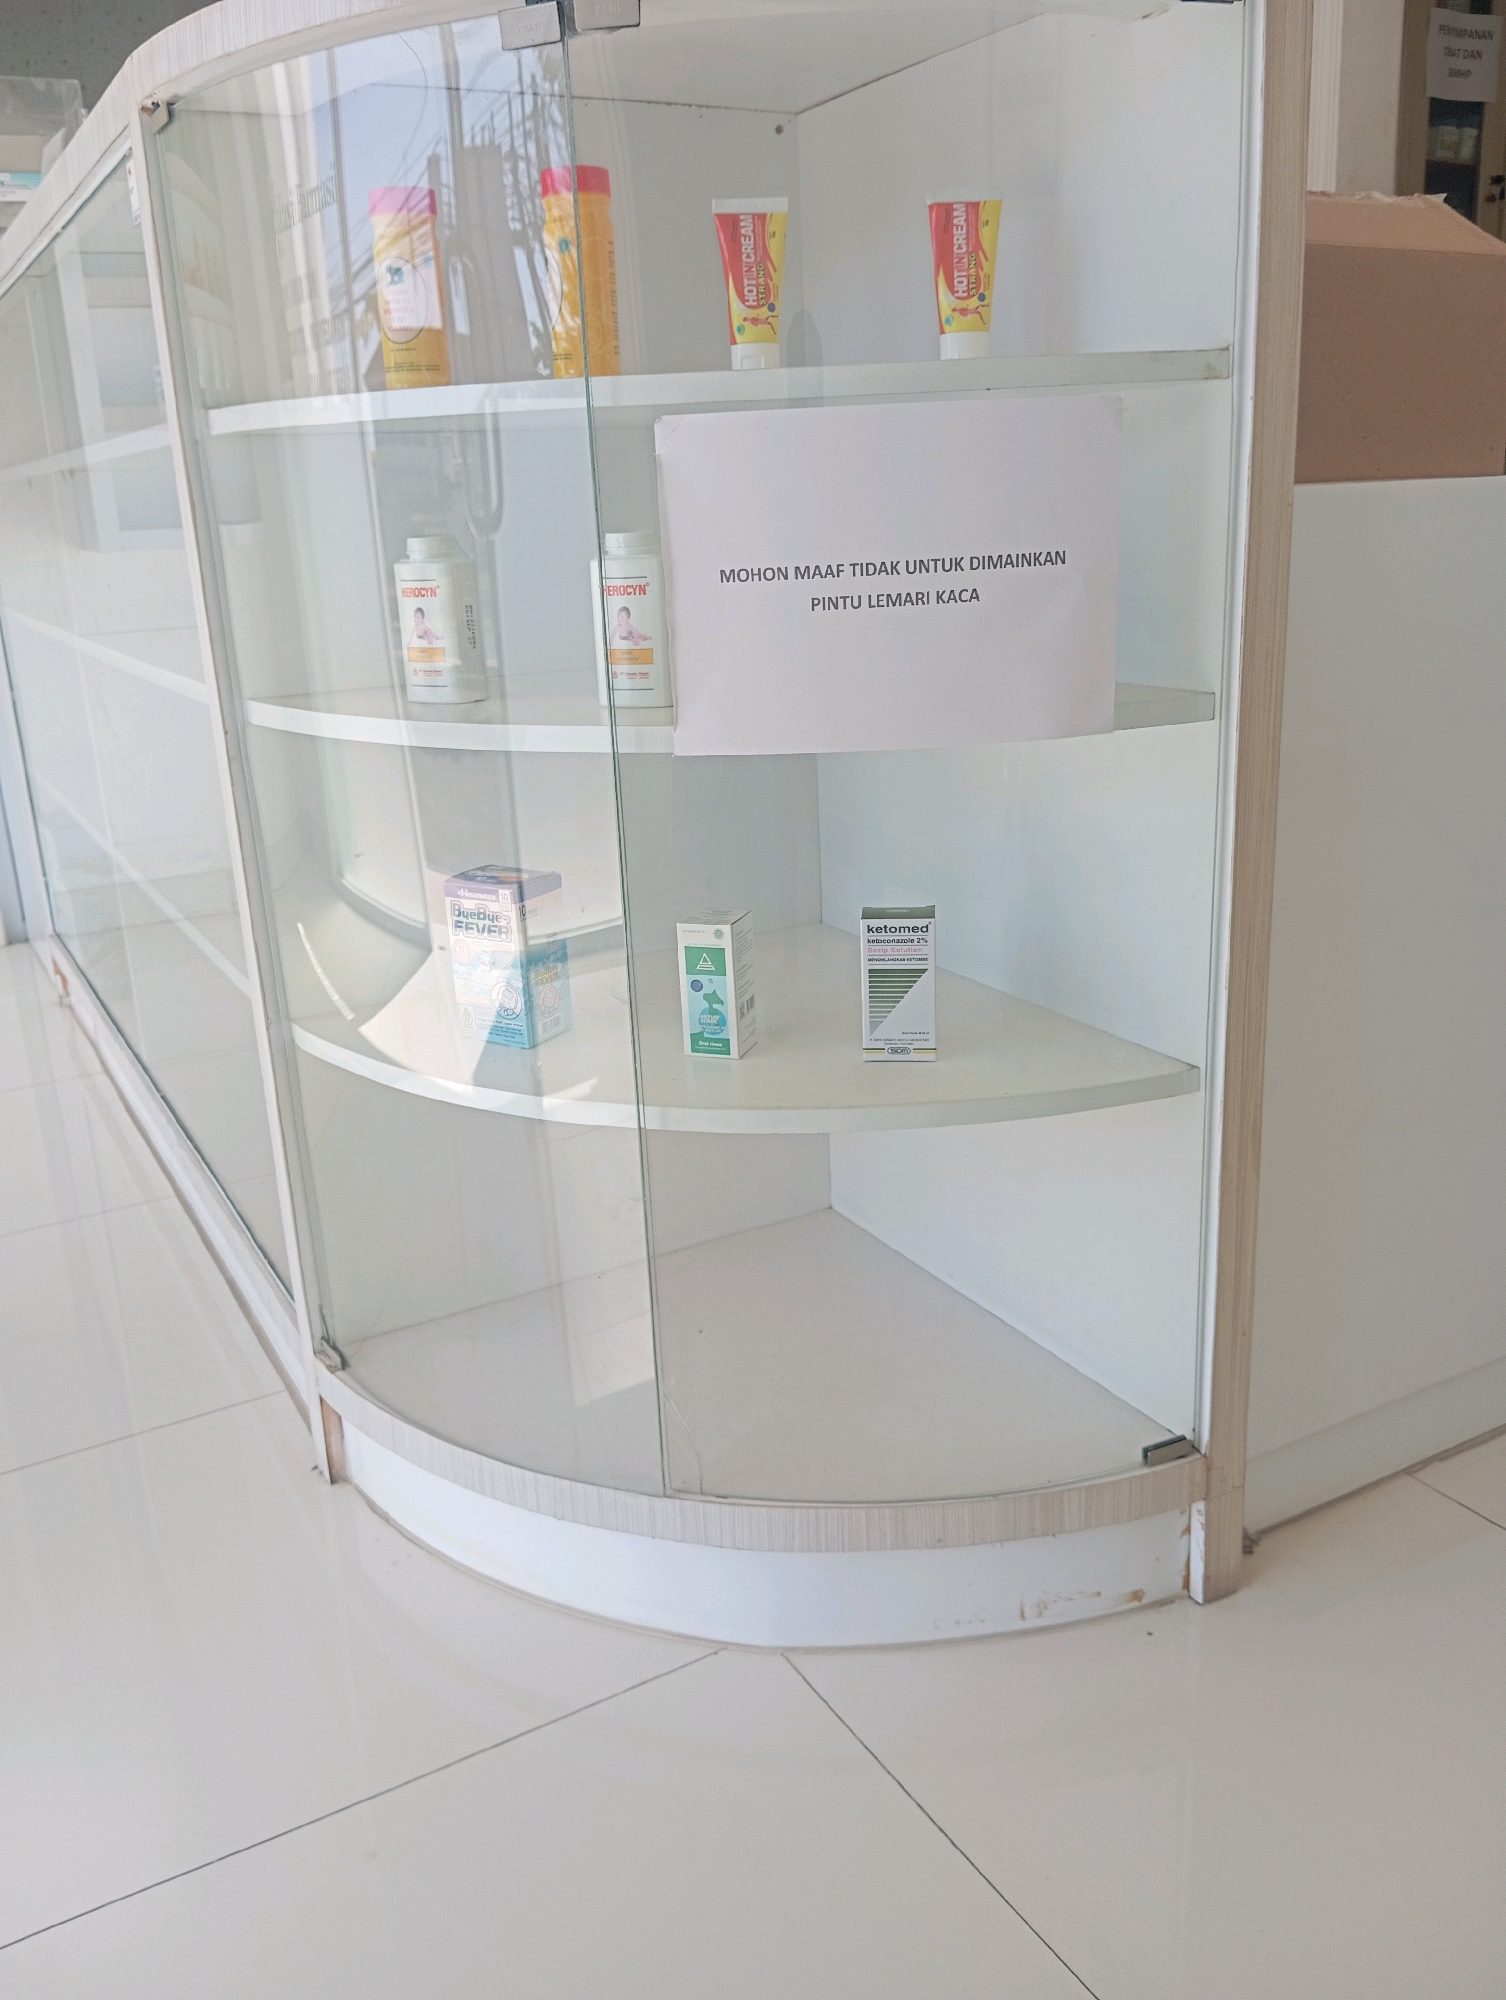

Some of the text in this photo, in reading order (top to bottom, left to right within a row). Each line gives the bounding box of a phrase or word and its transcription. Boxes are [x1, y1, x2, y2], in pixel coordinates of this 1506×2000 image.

[1463, 48, 1483, 60] DAN
[739, 215, 755, 262] CREAM
[953, 203, 967, 254] CREAM
[743, 279, 758, 306] HOT
[953, 271, 968, 297] HOT
[719, 550, 1066, 584] MOHON MAAF TIDAK UNTUK DIMAINKAN
[401, 586, 438, 598] HEROCYN
[811, 588, 980, 612] PINTU LEMARI KACA
[500, 892, 509, 902] 10
[453, 920, 511, 940] FEVER
[866, 924, 929, 934] ketomed
